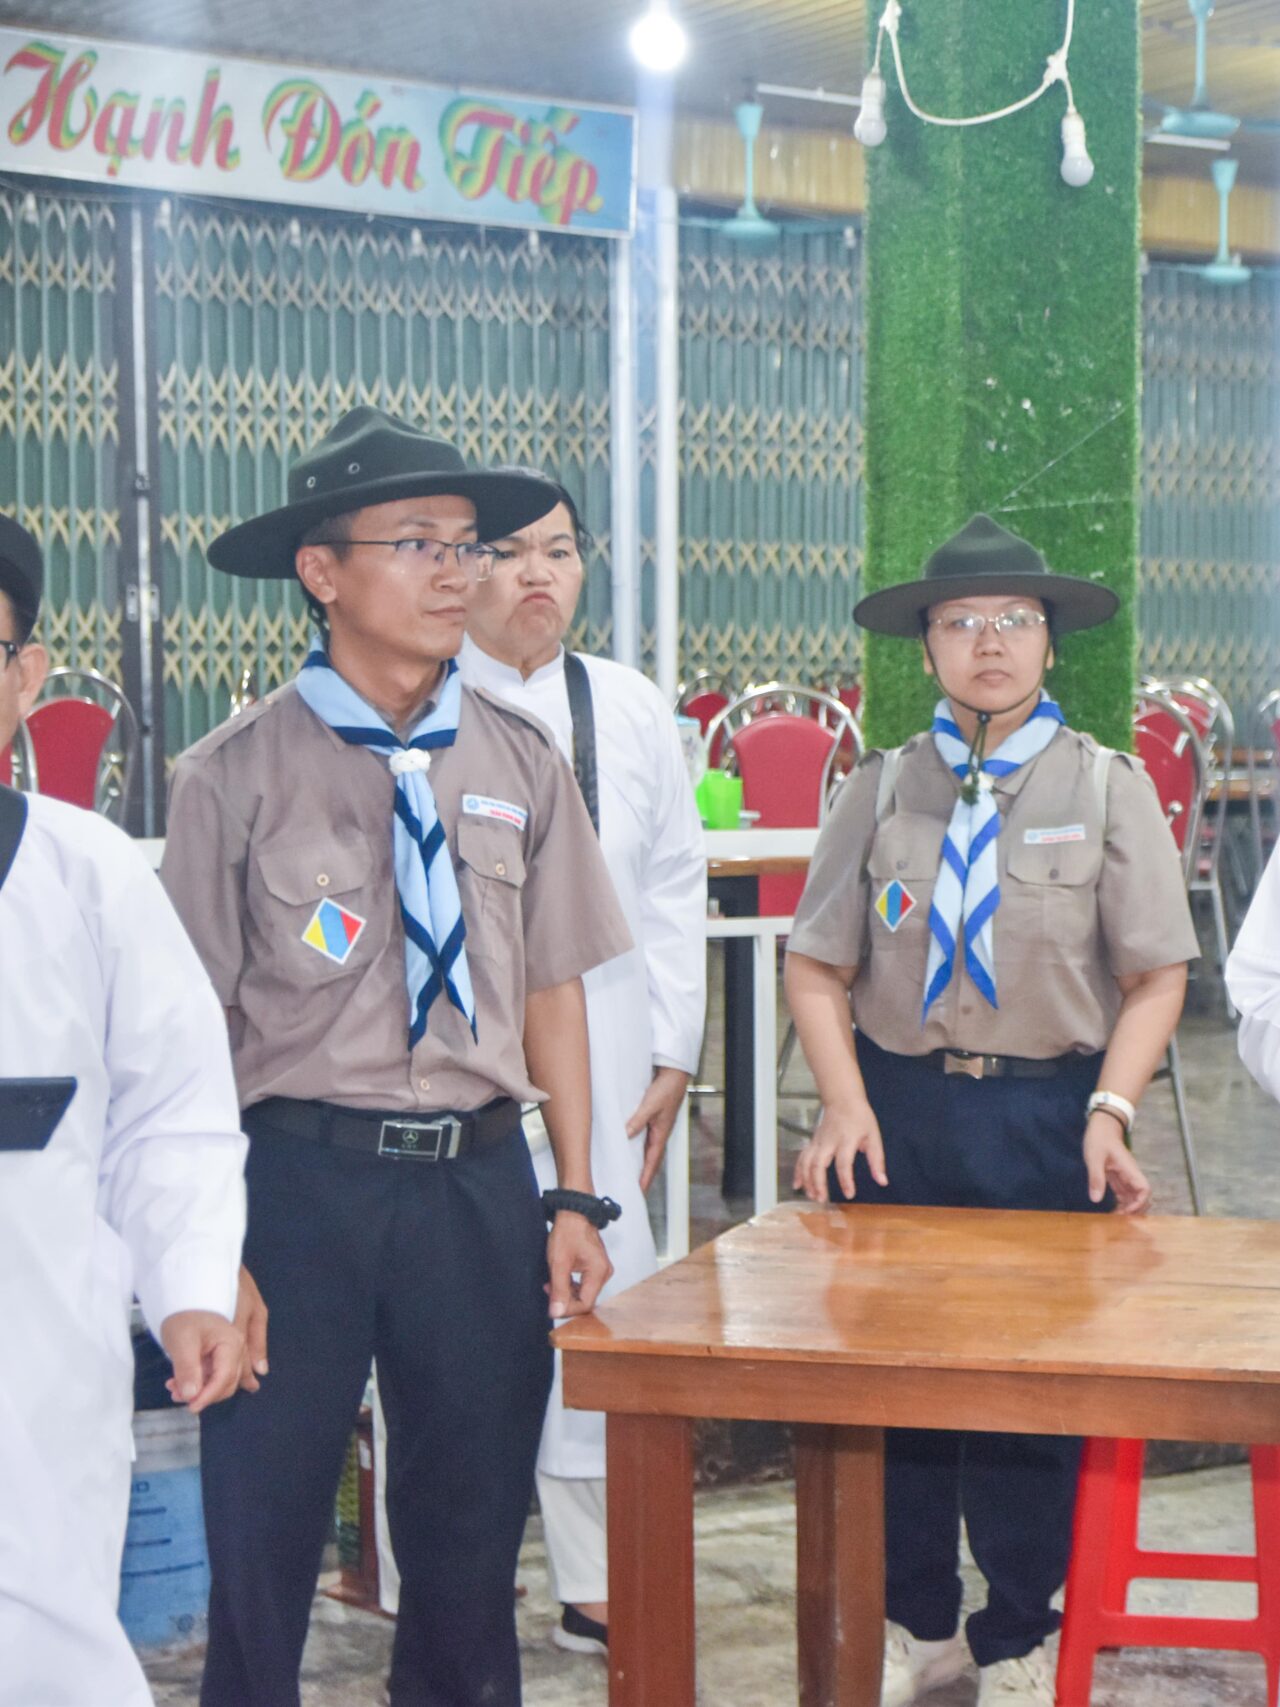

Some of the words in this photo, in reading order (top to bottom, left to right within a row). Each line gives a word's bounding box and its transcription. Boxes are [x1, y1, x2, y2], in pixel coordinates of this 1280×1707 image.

[4, 40, 241, 177] Hạnh
[262, 79, 426, 193] Đón
[438, 97, 605, 226] Tiếp
